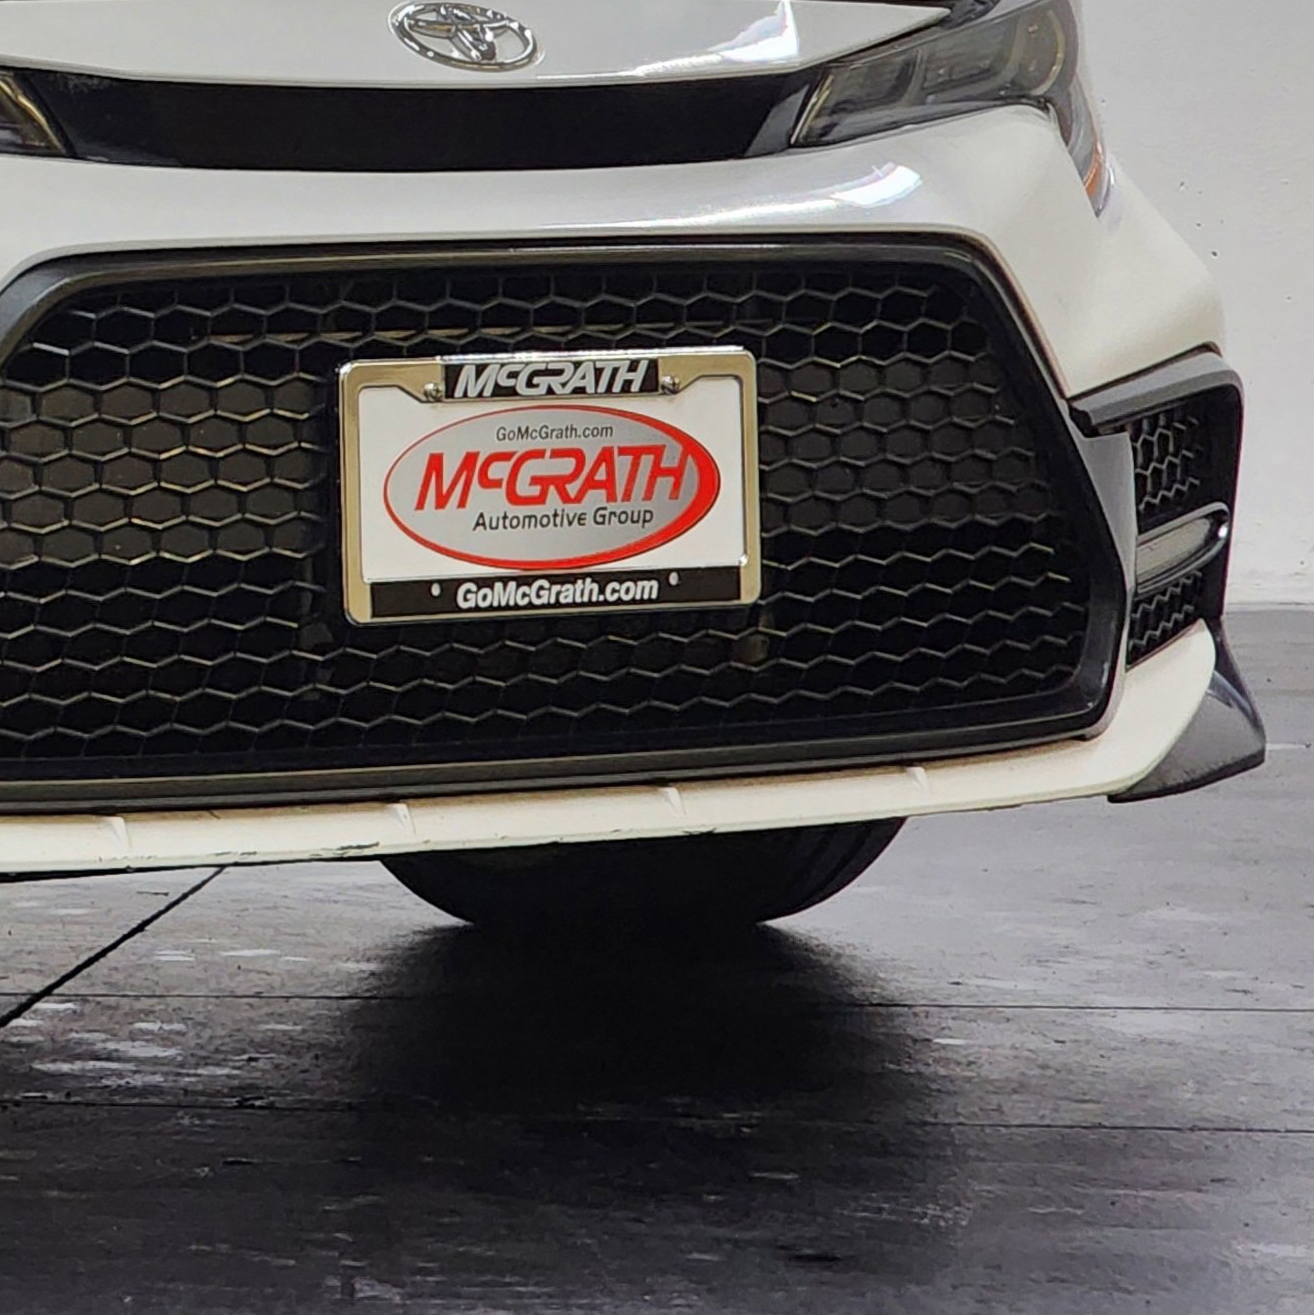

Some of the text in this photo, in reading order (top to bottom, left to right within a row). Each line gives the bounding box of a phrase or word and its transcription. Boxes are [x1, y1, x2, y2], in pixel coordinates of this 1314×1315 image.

[496, 423, 614, 442] GoMcGrath.com
[473, 505, 654, 532] Automotive Group
[456, 577, 659, 610] GoMcGrath.com
